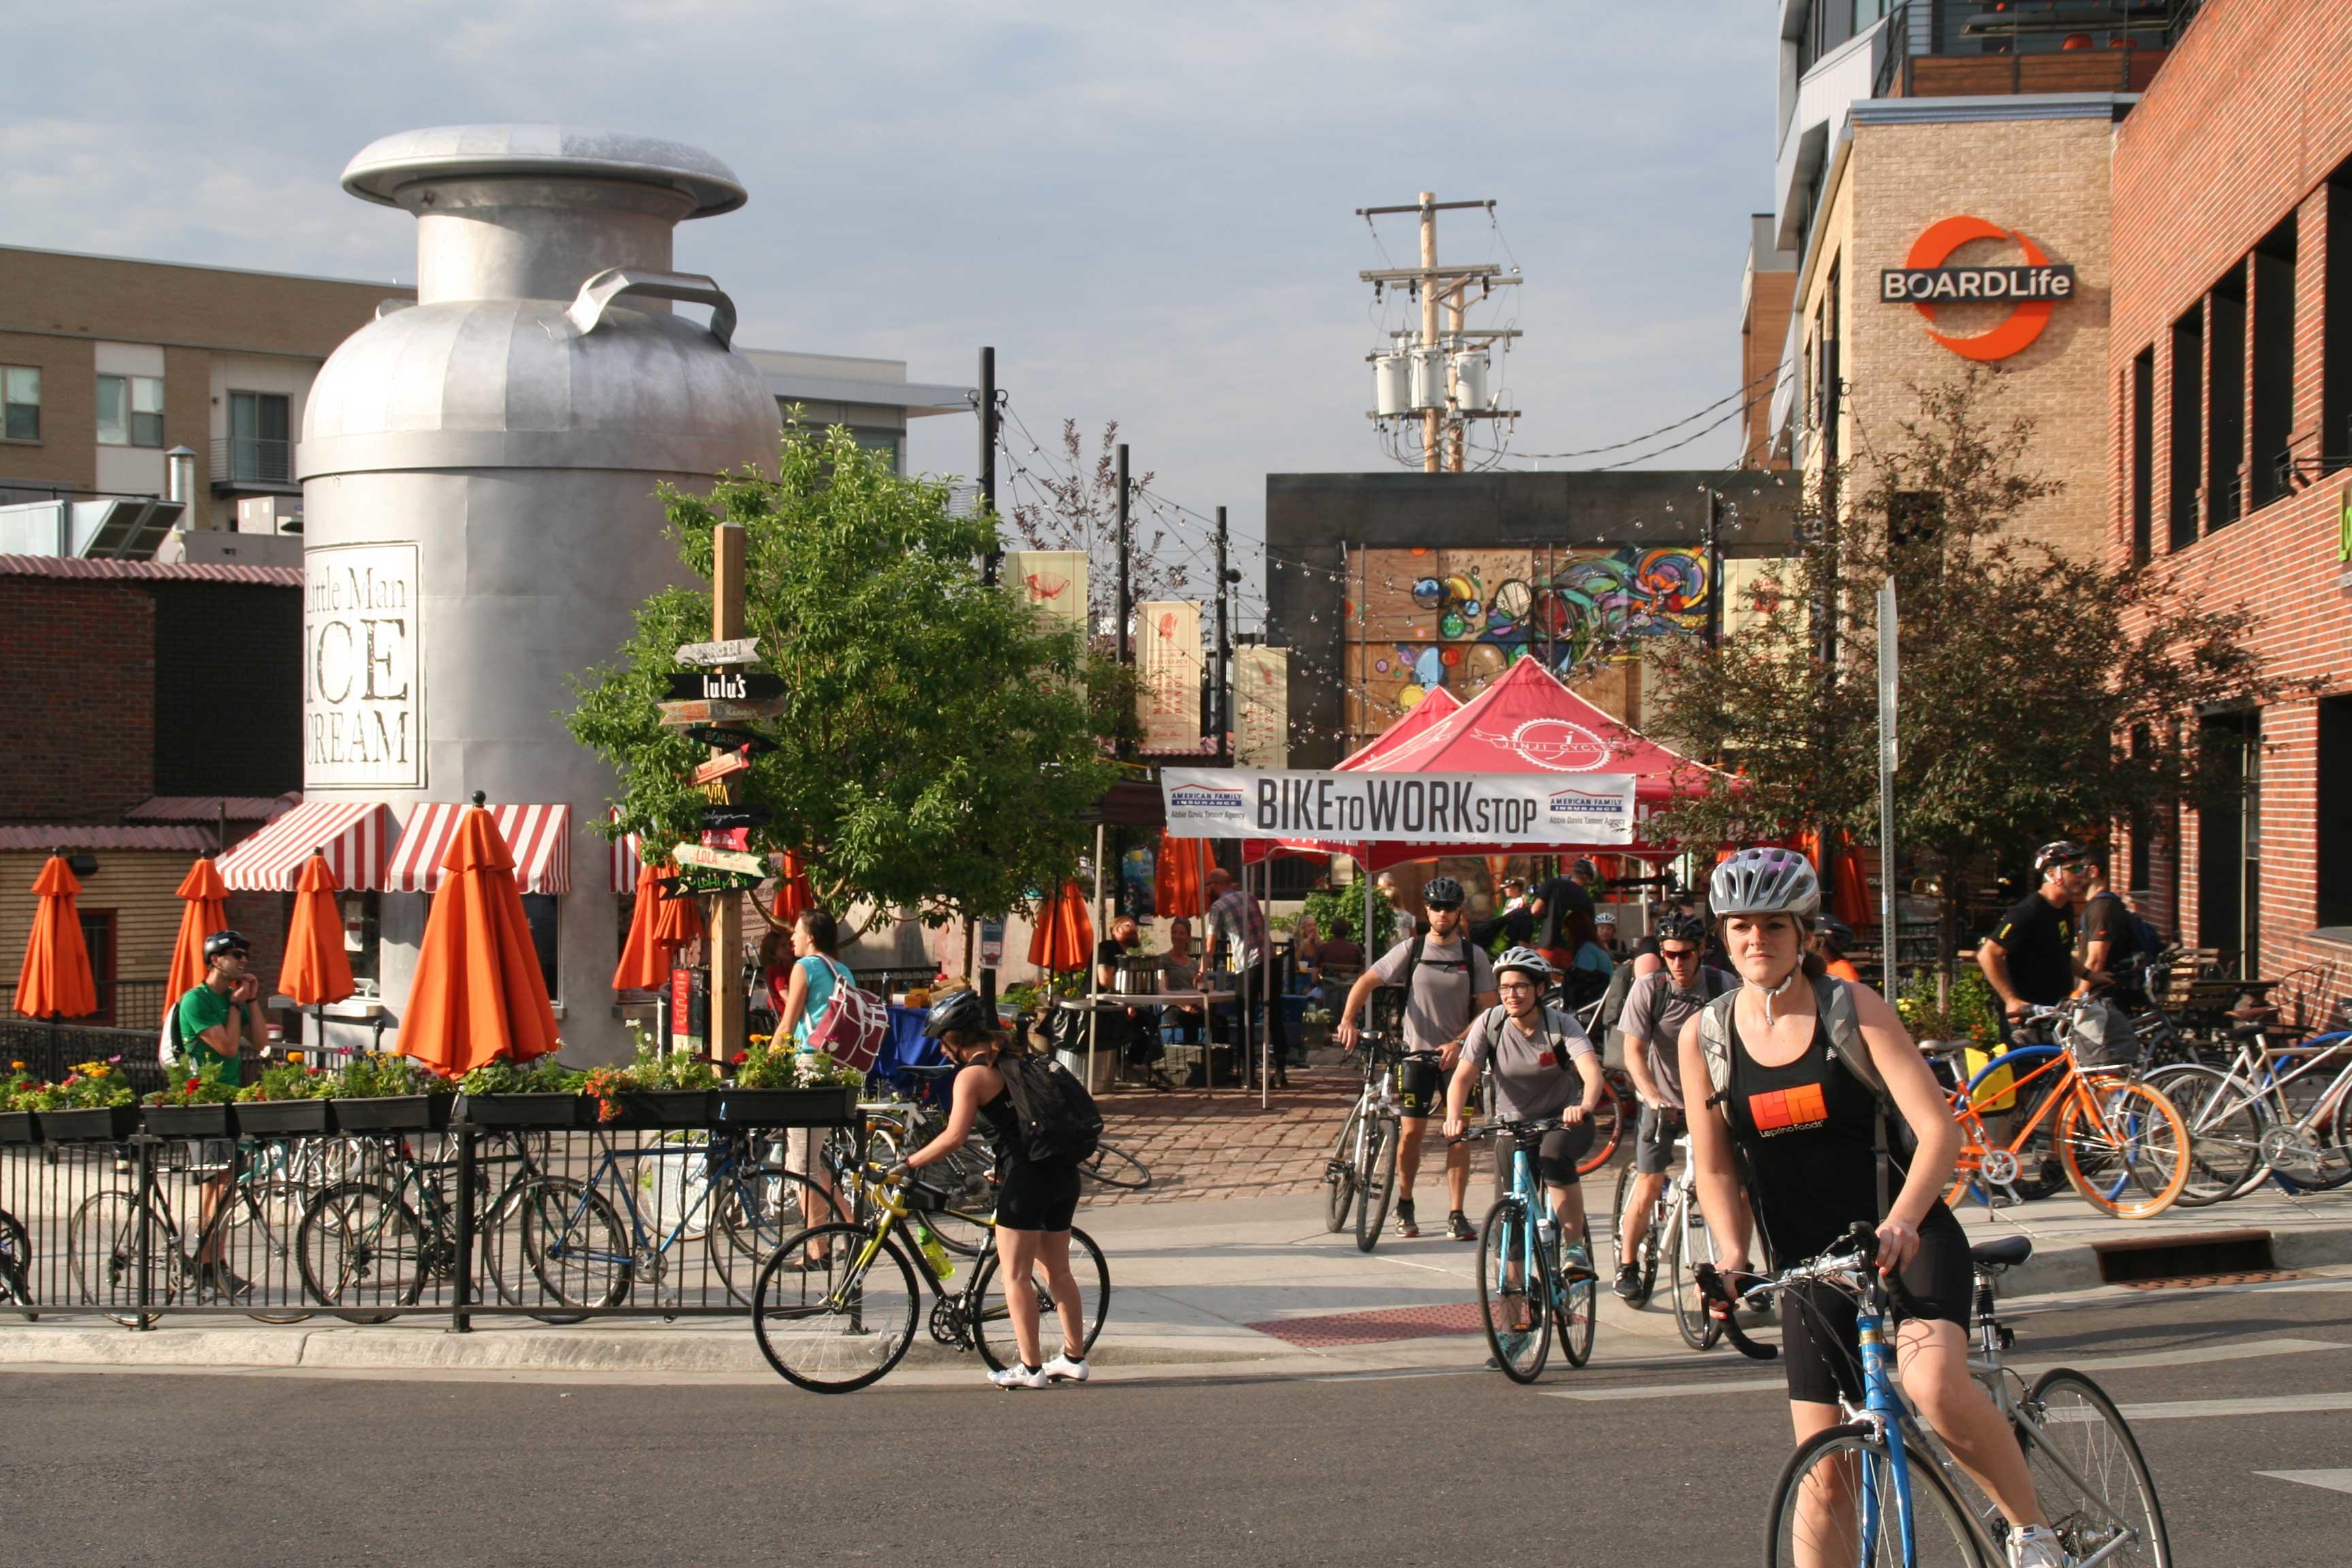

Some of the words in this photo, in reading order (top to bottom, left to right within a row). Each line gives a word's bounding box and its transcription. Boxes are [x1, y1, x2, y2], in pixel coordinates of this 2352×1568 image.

[1884, 269, 2070, 298] BOARDLife
[348, 567, 406, 610] Man
[306, 619, 408, 705] ICE
[703, 674, 746, 699] lulu's
[1175, 674, 1183, 715] DANCE
[306, 710, 408, 765] CREAM
[1503, 742, 1547, 751] JINJI
[1188, 811, 1204, 819] Davis
[1225, 811, 1245, 821] Agency
[1257, 779, 1334, 830] BIKE
[1367, 780, 1474, 833] WORK
[1476, 798, 1537, 834] STOP
[1567, 816, 1583, 824] Davis
[1605, 816, 1625, 827] Agency
[696, 849, 719, 865] LOLA
[1759, 1126, 1795, 1138] Leprino
